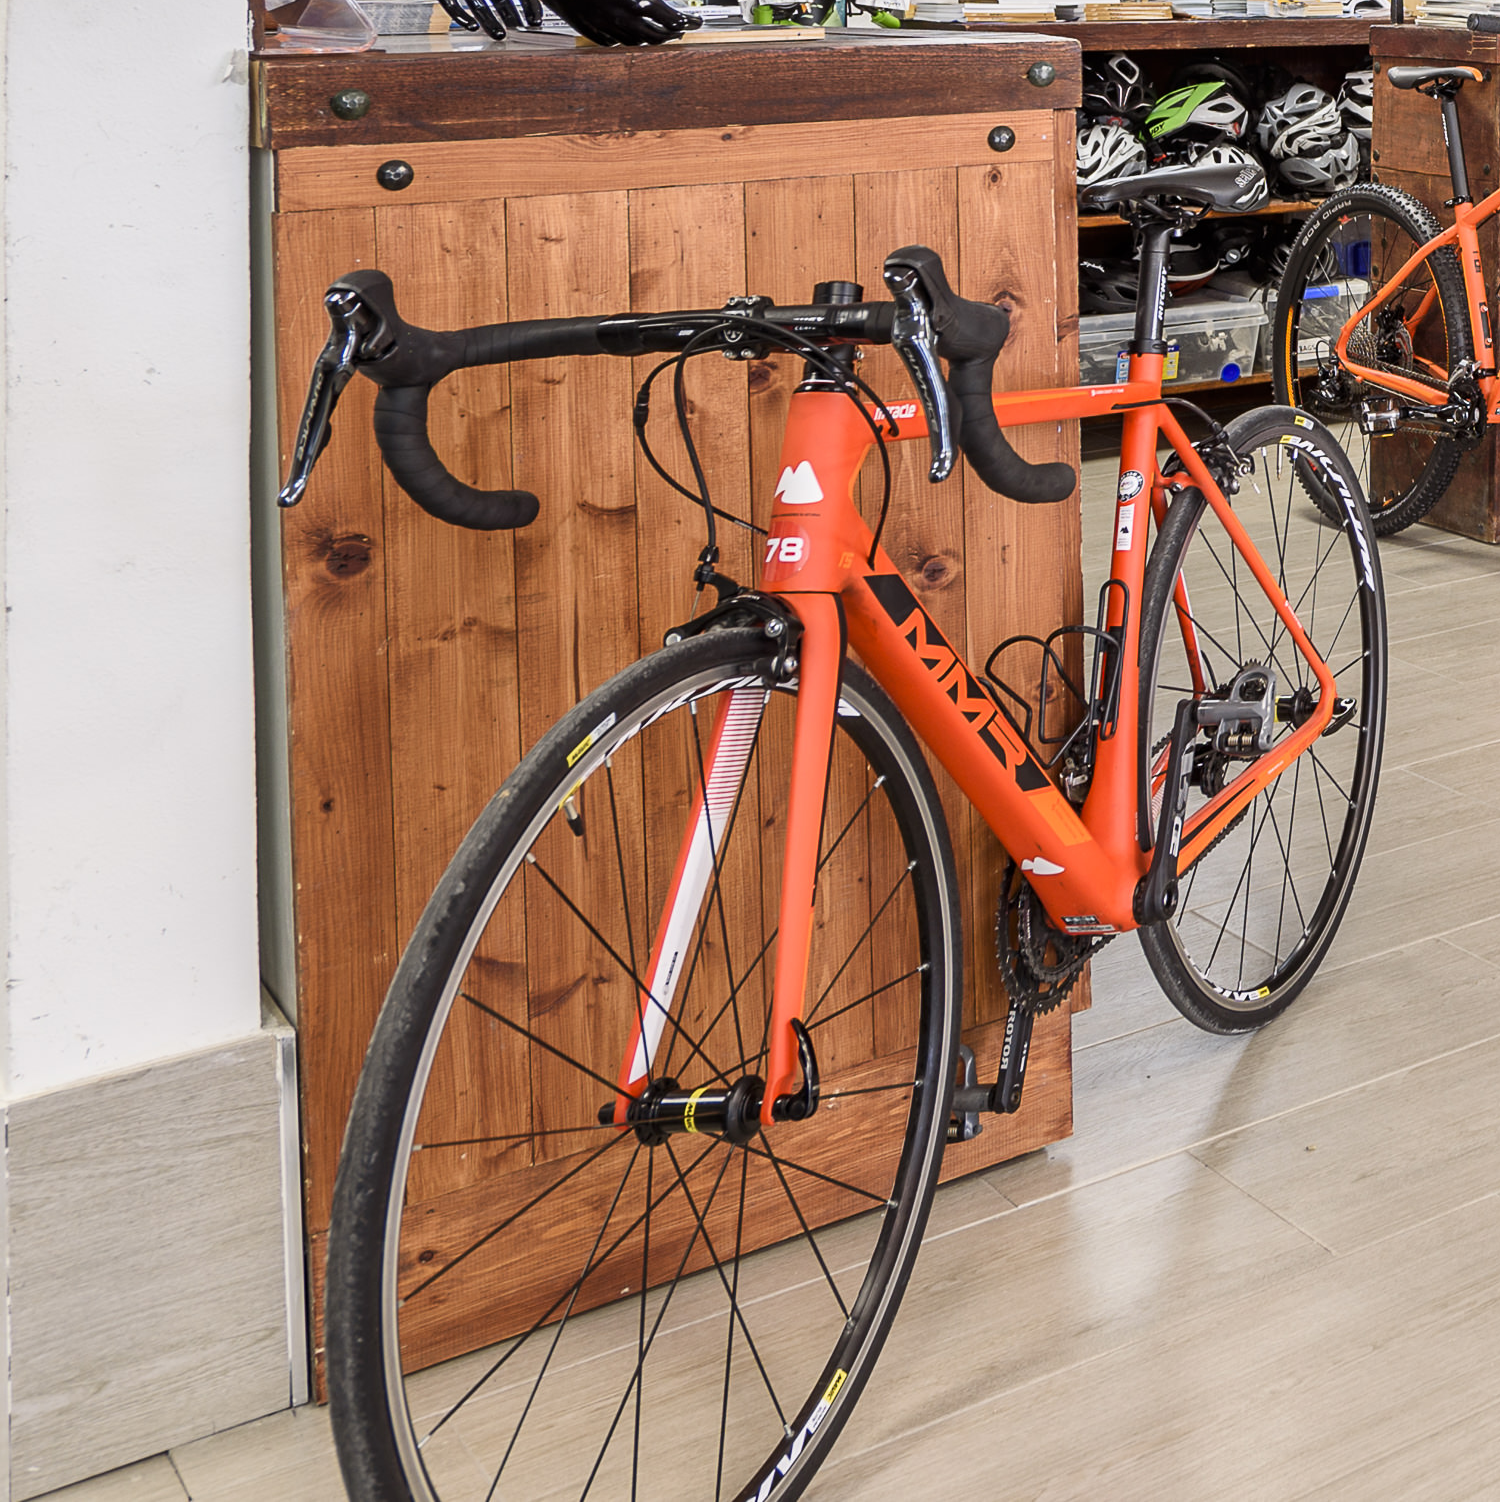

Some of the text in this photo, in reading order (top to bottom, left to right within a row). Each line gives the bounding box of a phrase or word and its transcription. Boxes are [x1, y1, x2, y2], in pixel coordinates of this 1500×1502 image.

[1157, 267, 1168, 321] RITCHEY
[764, 537, 804, 563] 78
[903, 608, 1027, 777] MMR
